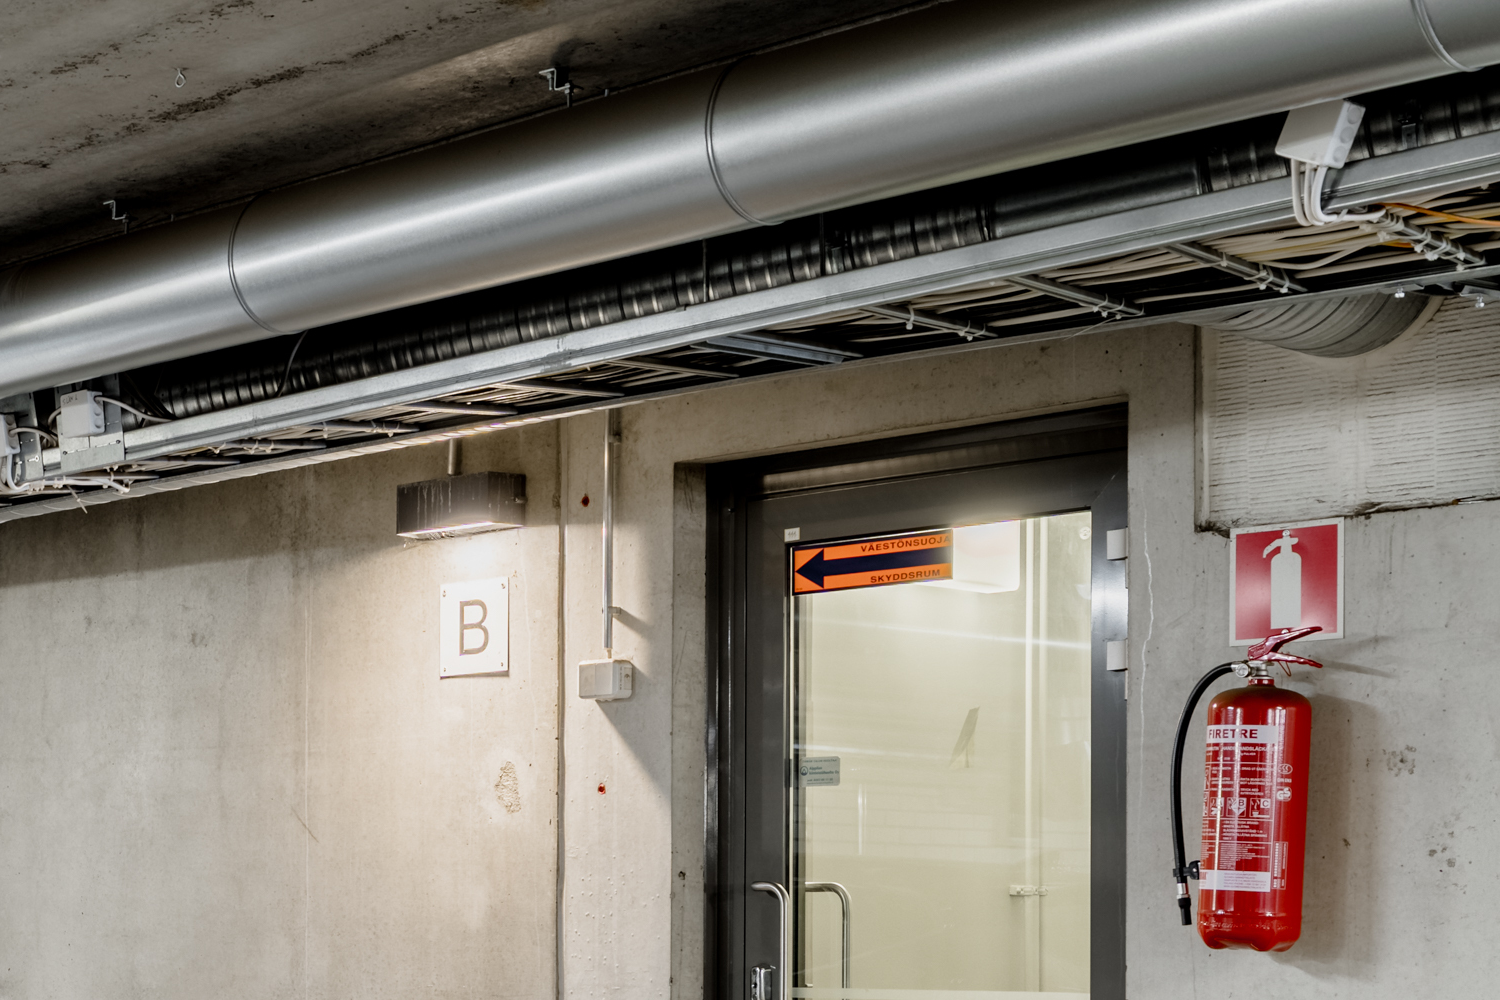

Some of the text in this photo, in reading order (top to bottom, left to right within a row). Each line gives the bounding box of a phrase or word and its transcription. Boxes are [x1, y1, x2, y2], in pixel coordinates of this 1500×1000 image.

[860, 536, 951, 552] VÄESTÖNSUOJA
[870, 569, 941, 584] SKYDDSRUM
[459, 599, 489, 656] B
